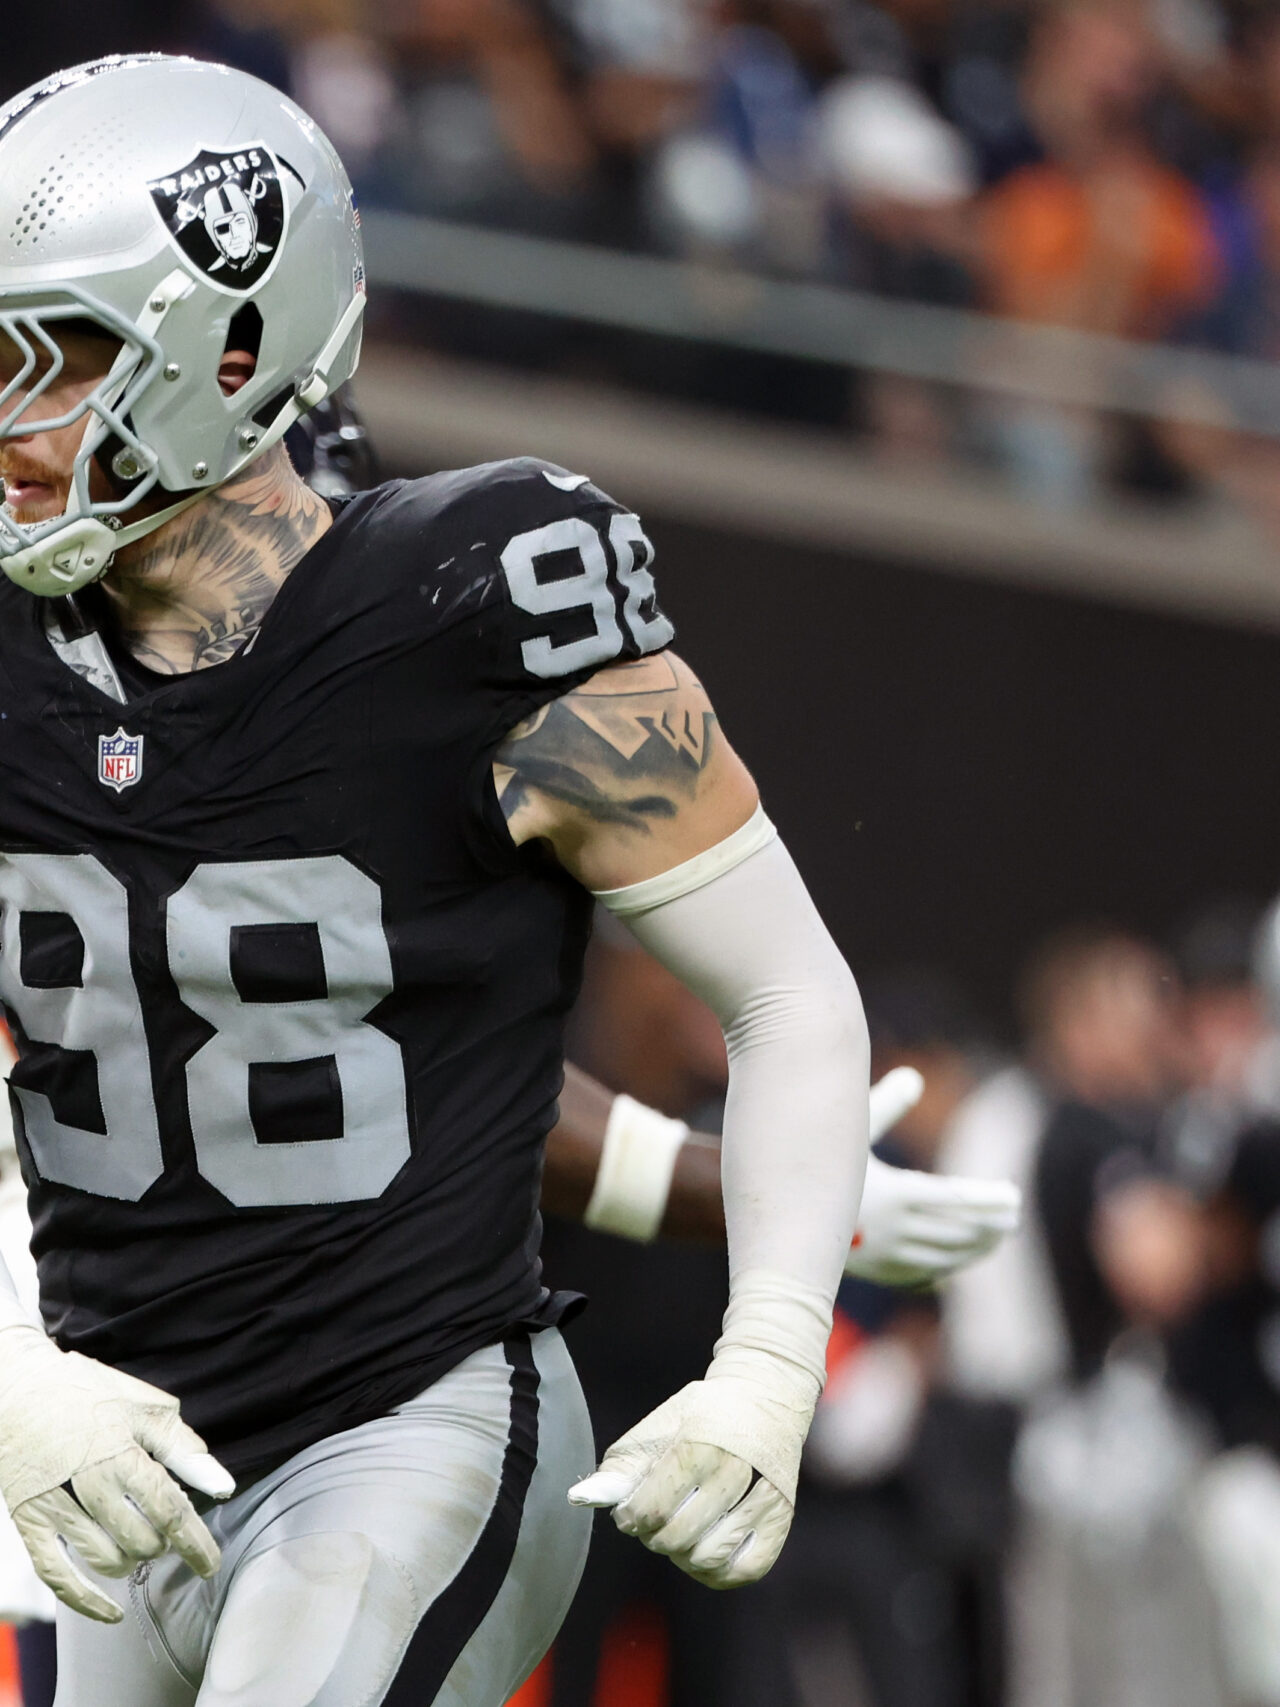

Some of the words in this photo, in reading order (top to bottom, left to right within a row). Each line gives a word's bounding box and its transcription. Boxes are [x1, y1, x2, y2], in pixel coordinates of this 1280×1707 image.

[159, 150, 261, 197] RAIDERS
[499, 513, 675, 680] 98
[104, 757, 135, 781] NFL
